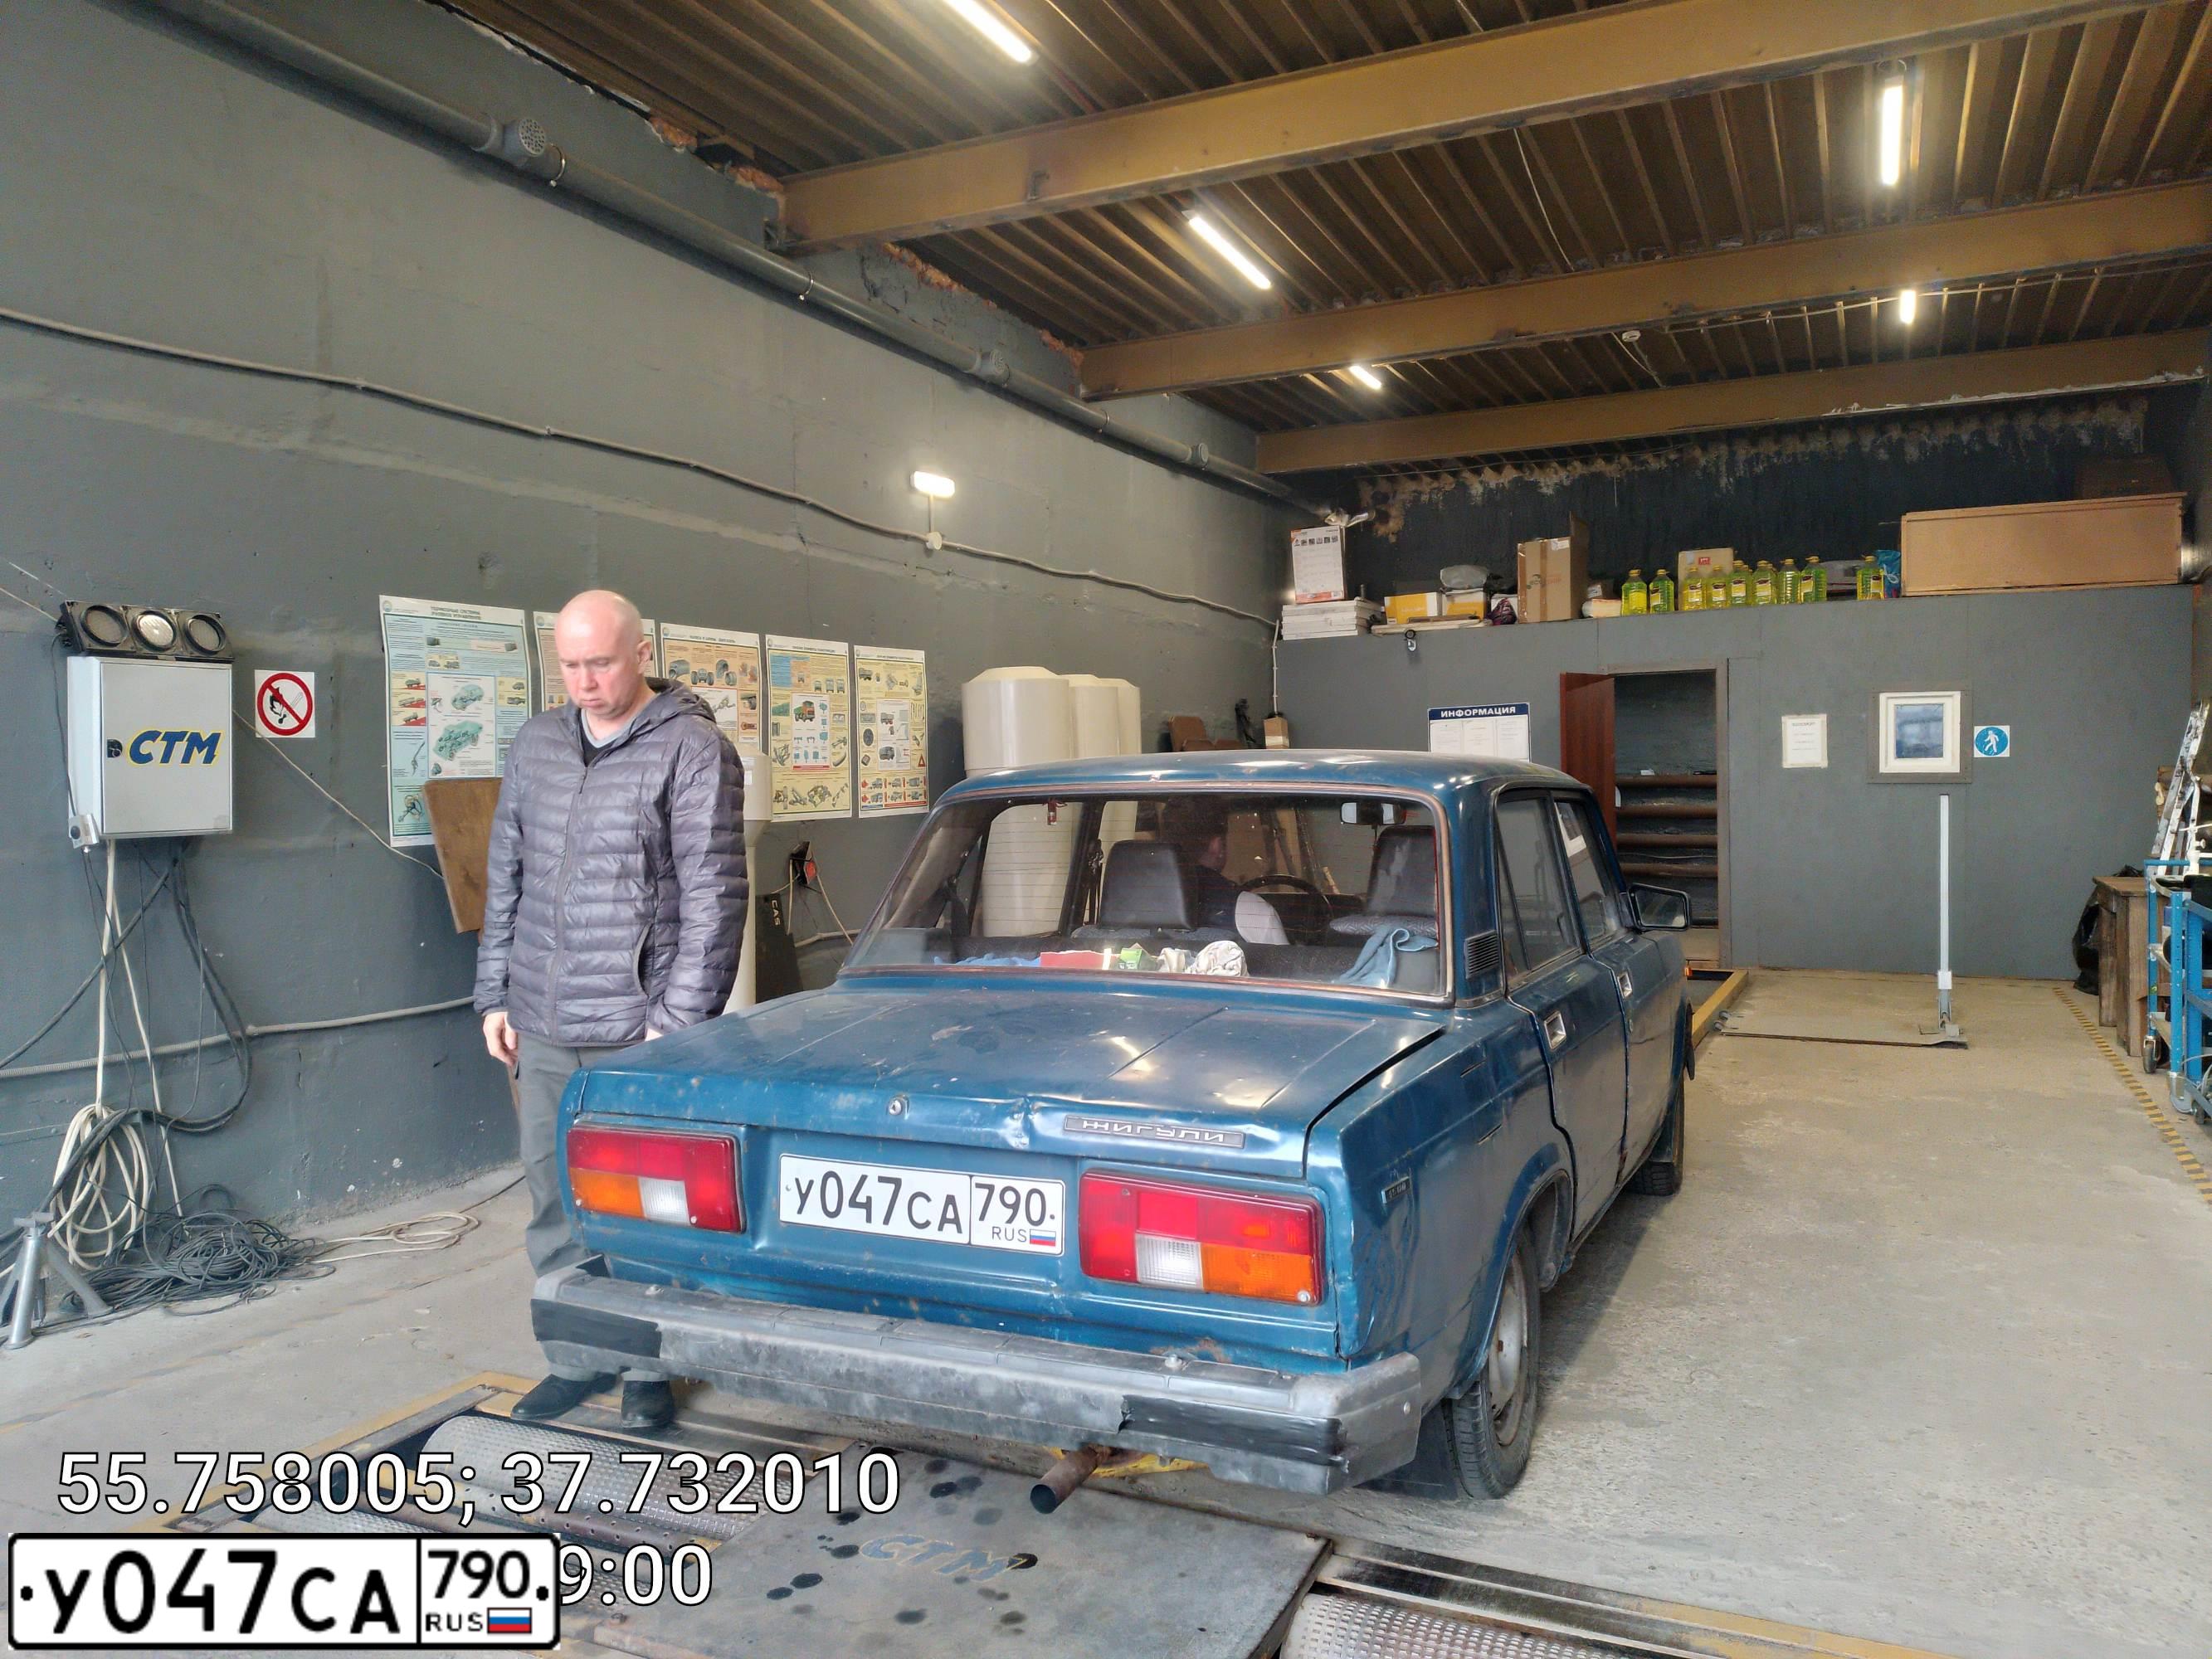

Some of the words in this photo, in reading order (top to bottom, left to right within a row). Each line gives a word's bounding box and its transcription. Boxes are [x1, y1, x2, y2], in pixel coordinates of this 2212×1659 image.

[1440, 706, 1516, 718] ИНФОРМАЦИЯ
[1083, 1120, 1224, 1142] ЖИГУЛИ
[794, 1170, 963, 1234] У047СА
[975, 1182, 1047, 1227] 790
[991, 1225, 1028, 1243] RUS
